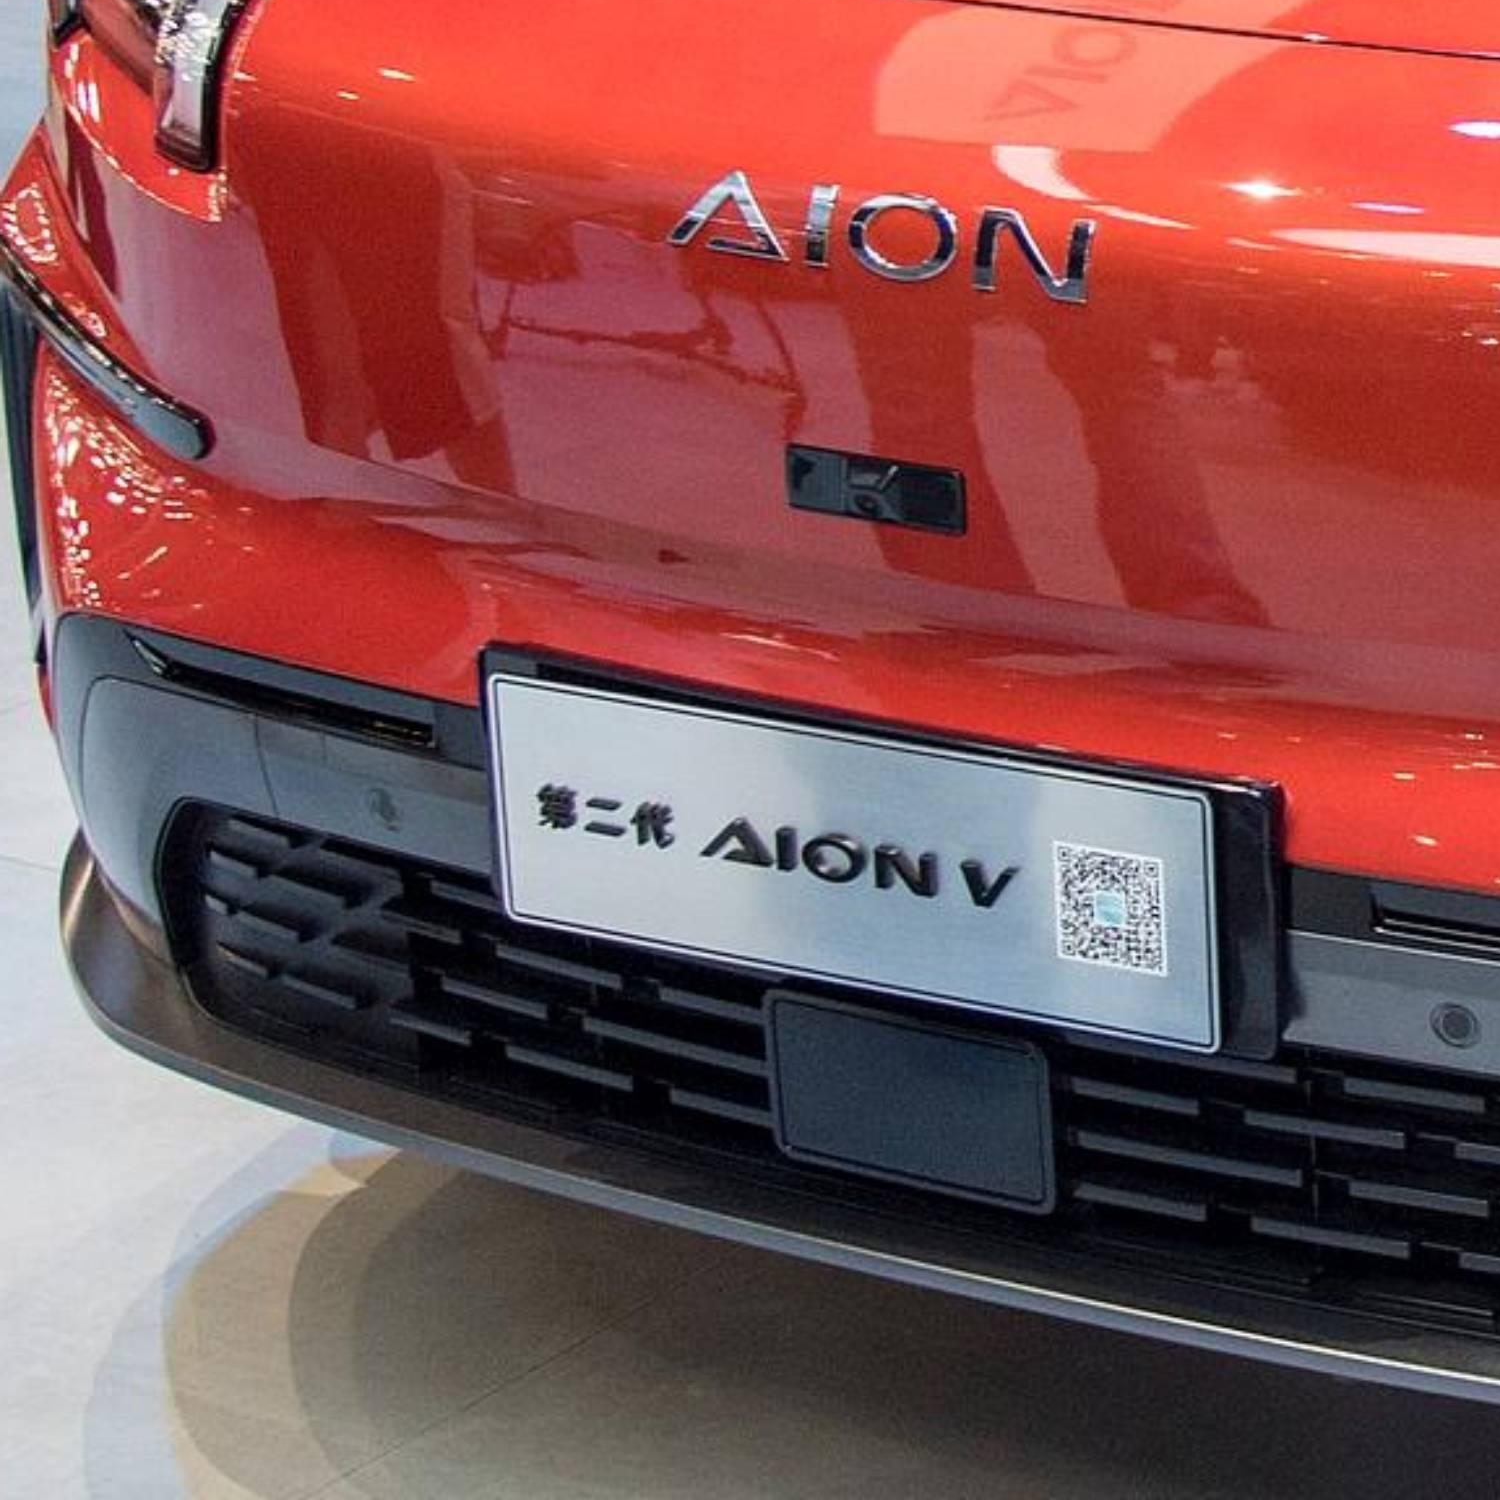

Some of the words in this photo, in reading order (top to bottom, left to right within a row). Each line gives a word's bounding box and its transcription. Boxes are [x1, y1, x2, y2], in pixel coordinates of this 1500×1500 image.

[667, 170, 1096, 304] AION
[536, 783, 677, 851] 第二代
[699, 816, 938, 898] AION
[959, 857, 1021, 909] V
